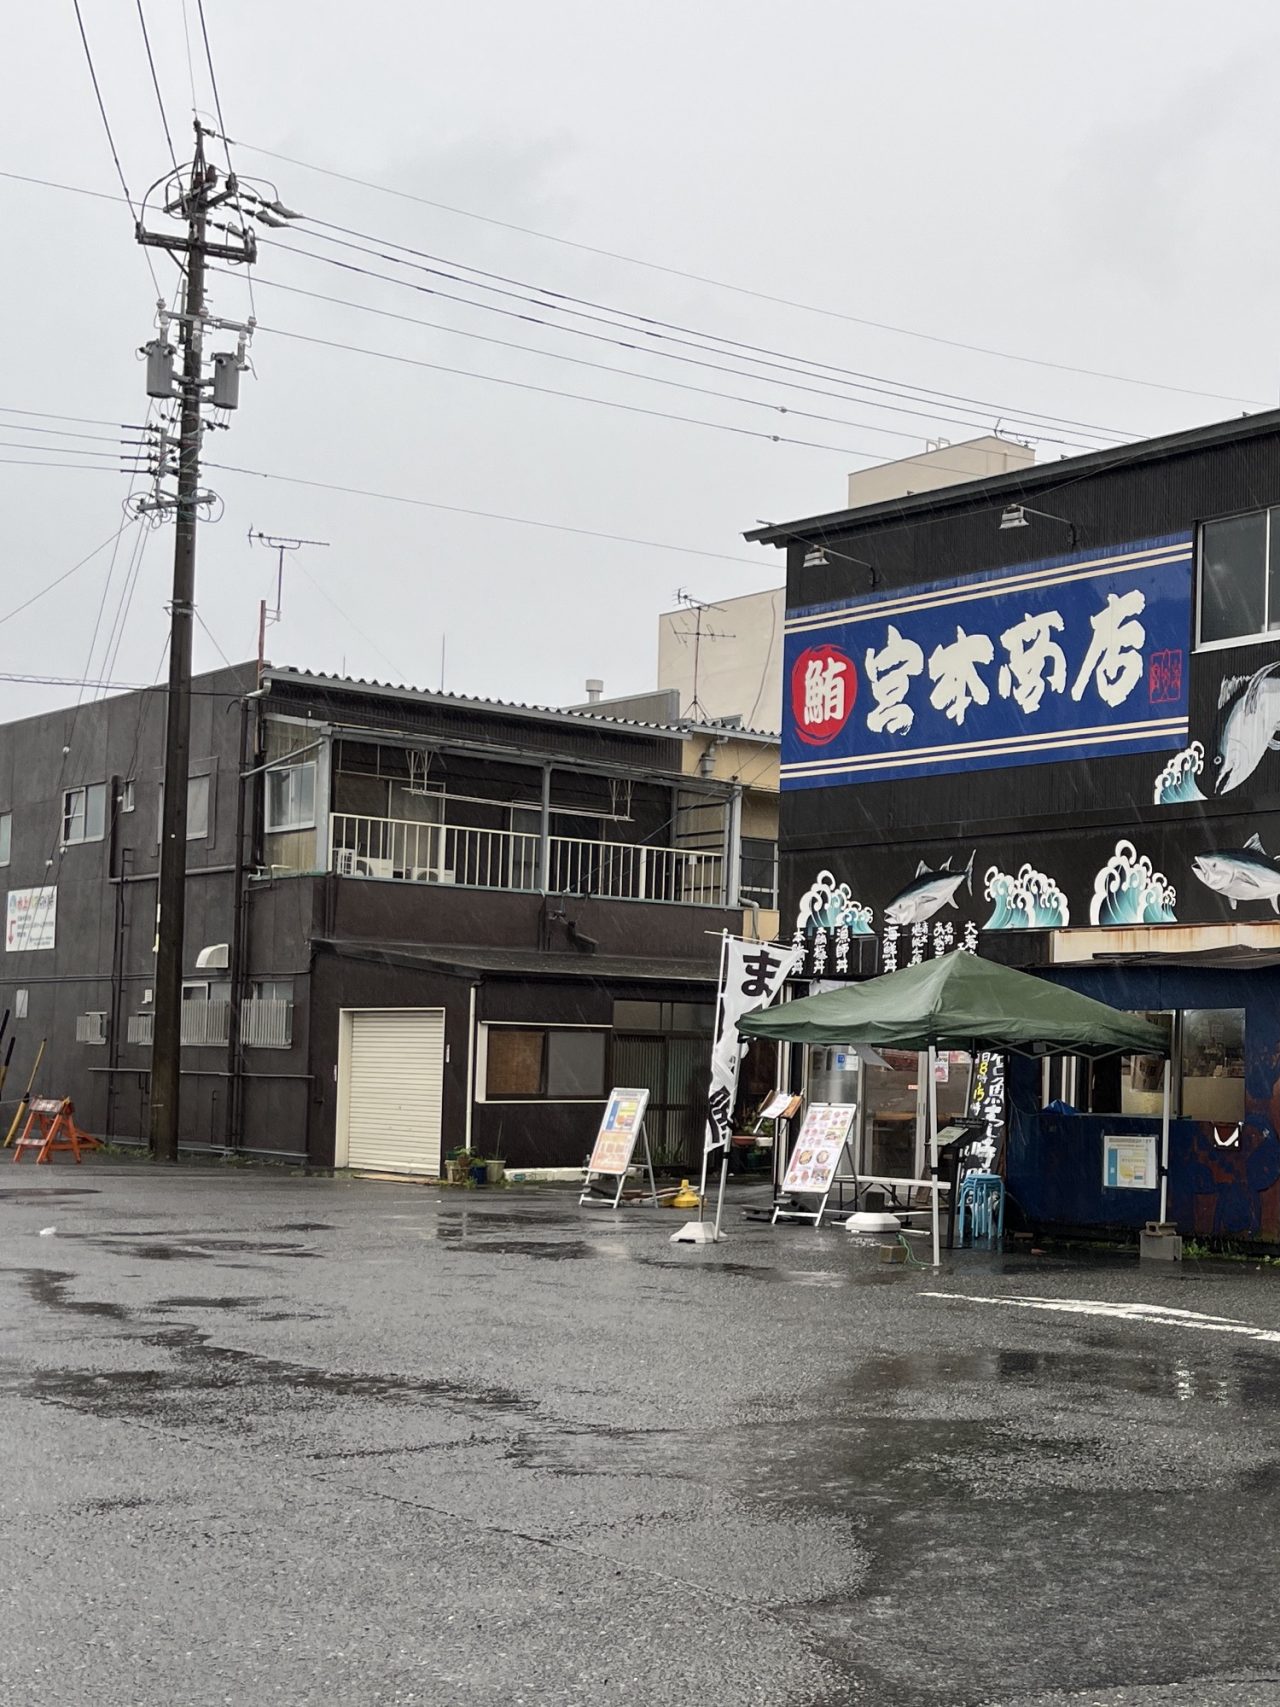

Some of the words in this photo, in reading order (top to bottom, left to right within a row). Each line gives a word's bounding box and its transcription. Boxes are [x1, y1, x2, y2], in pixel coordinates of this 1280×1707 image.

[804, 657, 847, 725] 鮪
[865, 589, 1146, 735] 宮本商店
[882, 926, 900, 973] 海鮮丼
